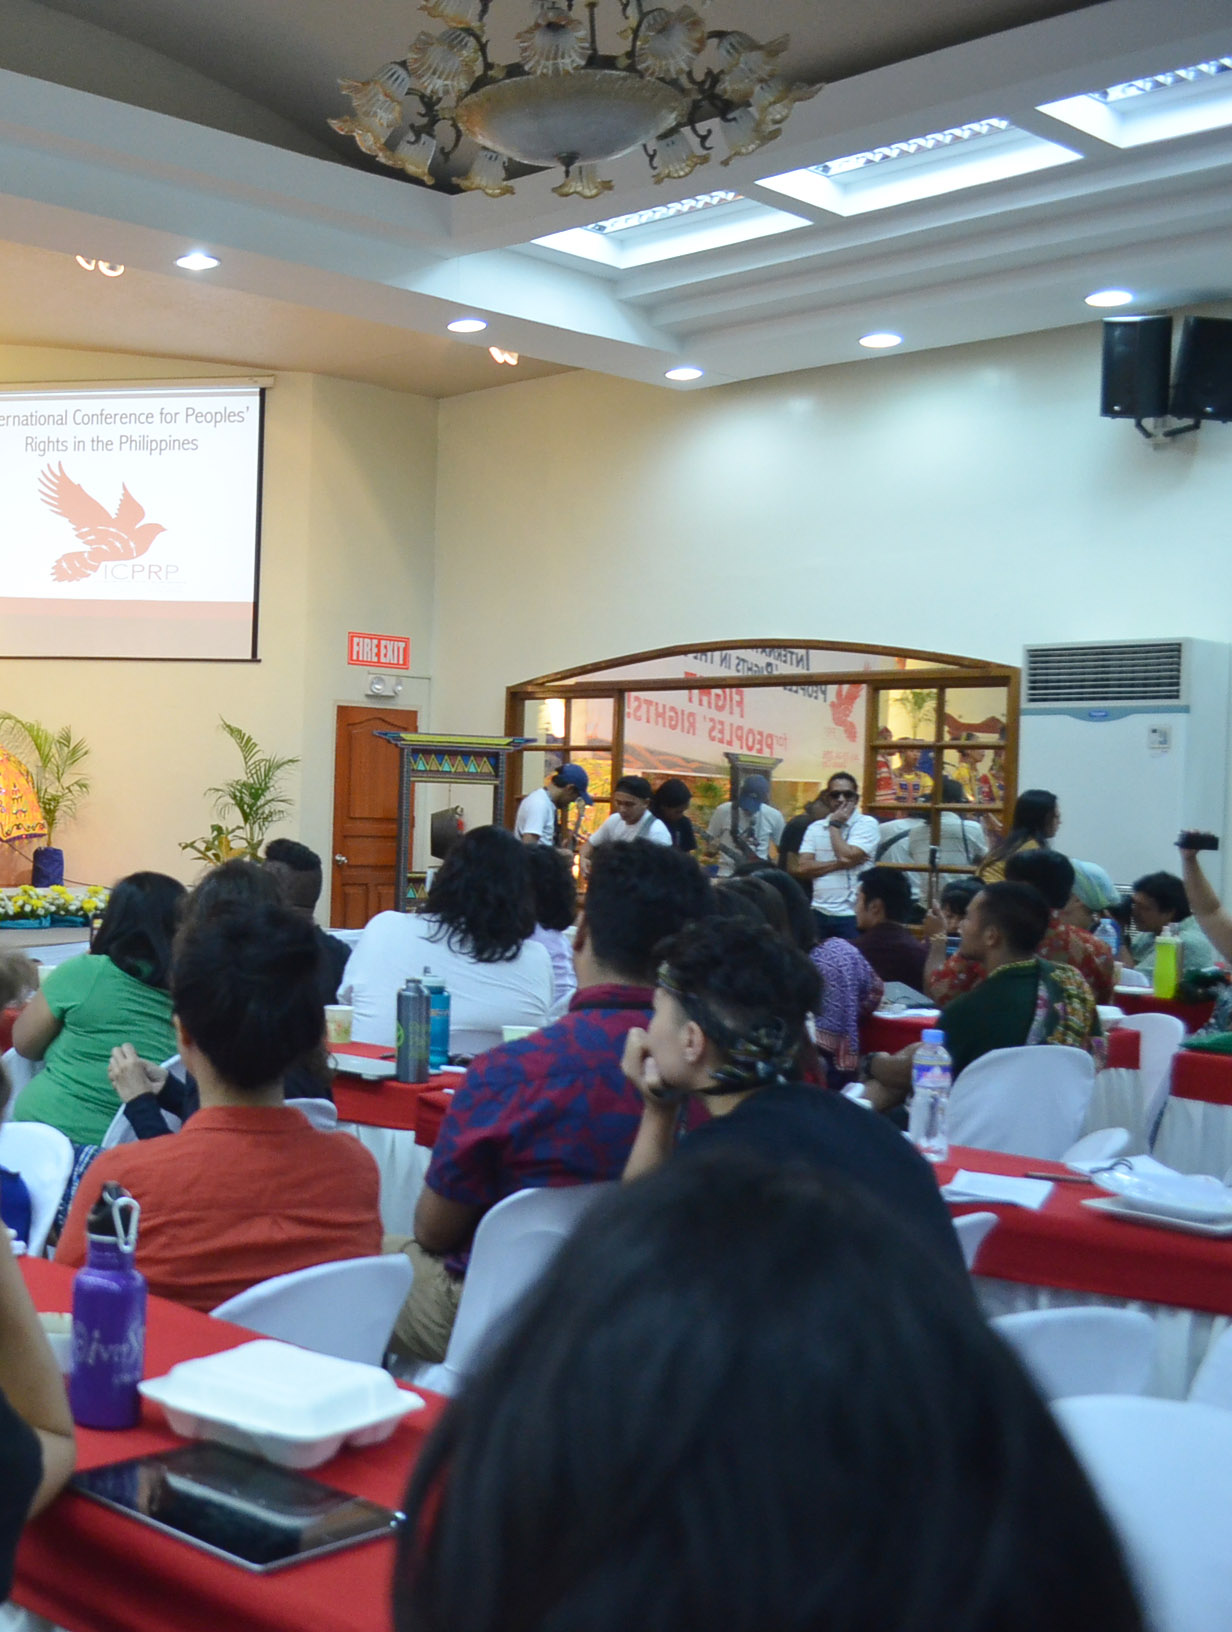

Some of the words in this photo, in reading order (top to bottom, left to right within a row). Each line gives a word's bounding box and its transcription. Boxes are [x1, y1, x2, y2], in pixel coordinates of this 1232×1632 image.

[72, 408, 155, 426] Conference
[159, 407, 180, 424] for
[185, 405, 250, 428] Peoples'
[24, 435, 69, 457] Rights
[73, 436, 86, 452] in
[91, 435, 114, 452] the
[119, 434, 199, 456] Philippines
[104, 563, 179, 580] ICPRP
[352, 637, 378, 662] FIRE
[380, 639, 406, 665] EXIT
